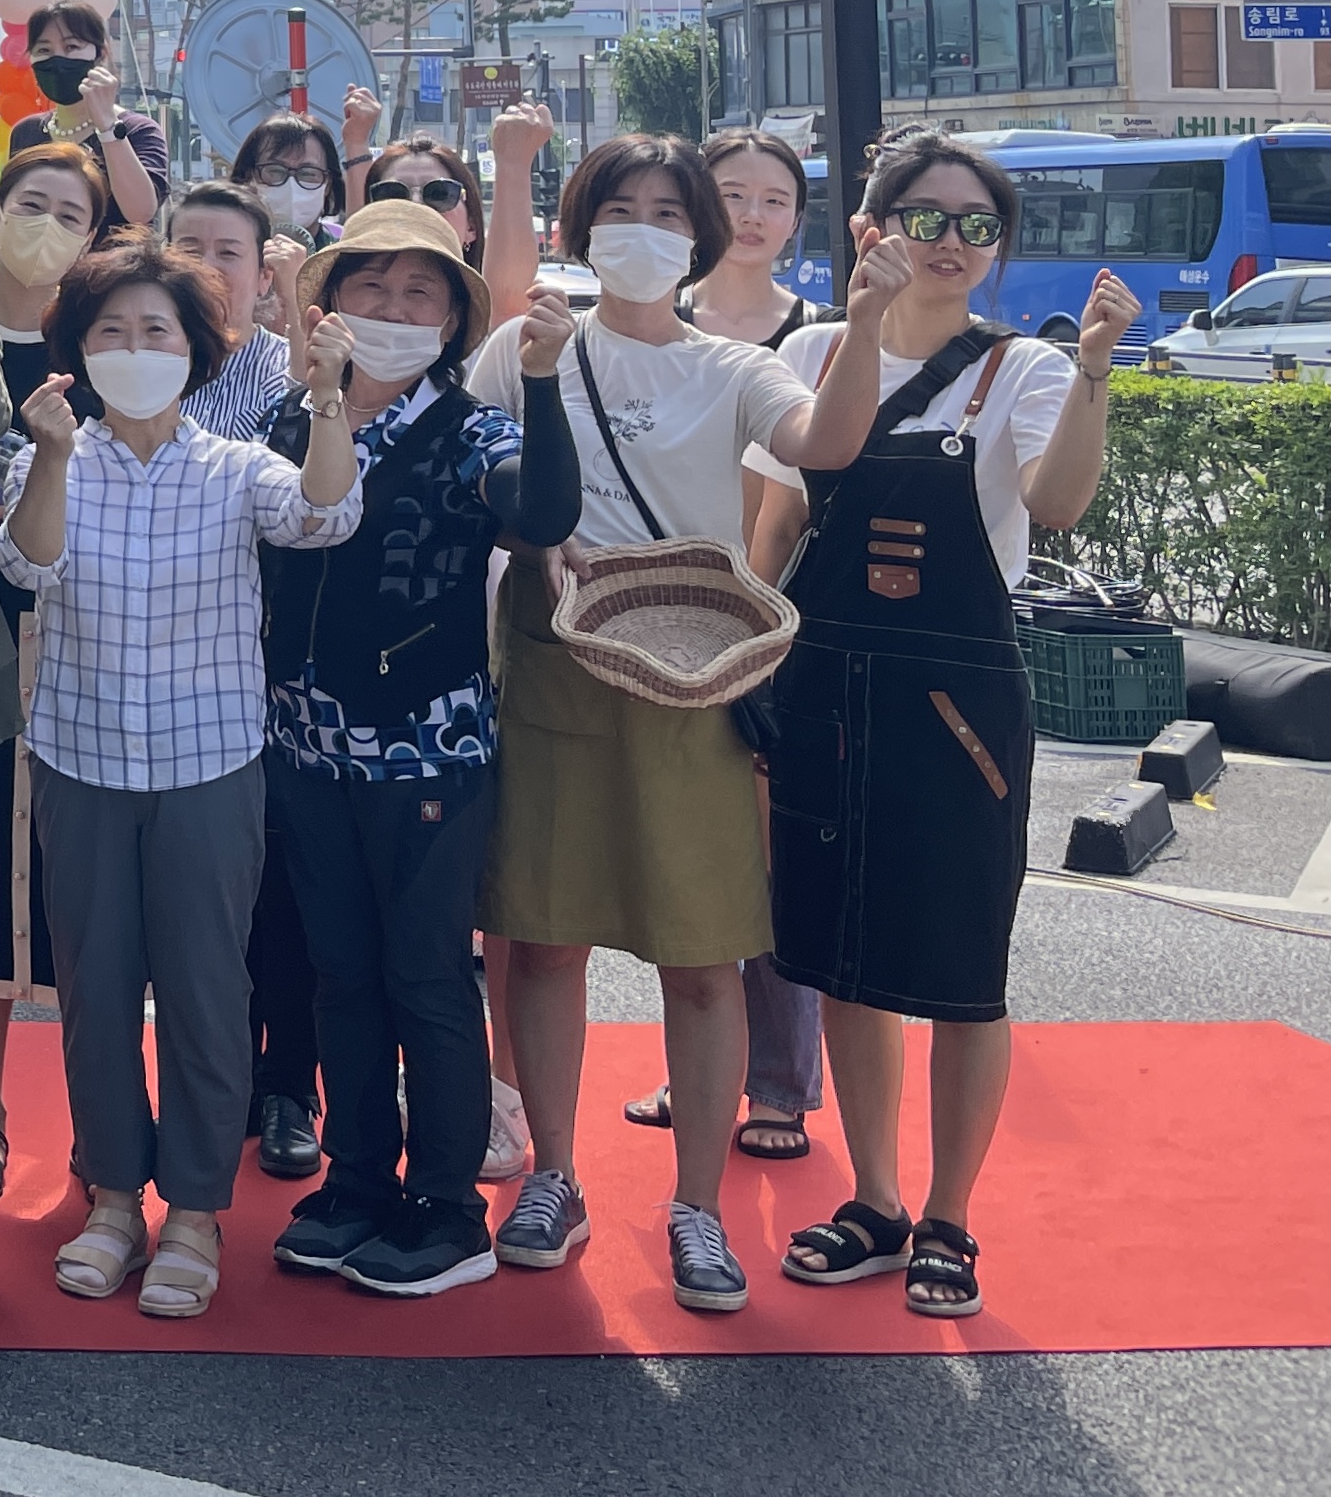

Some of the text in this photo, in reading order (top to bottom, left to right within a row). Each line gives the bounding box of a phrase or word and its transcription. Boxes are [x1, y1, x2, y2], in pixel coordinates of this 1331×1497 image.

[1248, 7, 1300, 25] 송림로
[1248, 26, 1305, 39] Songnim-ro
[928, 1258, 962, 1273] BALANCE
